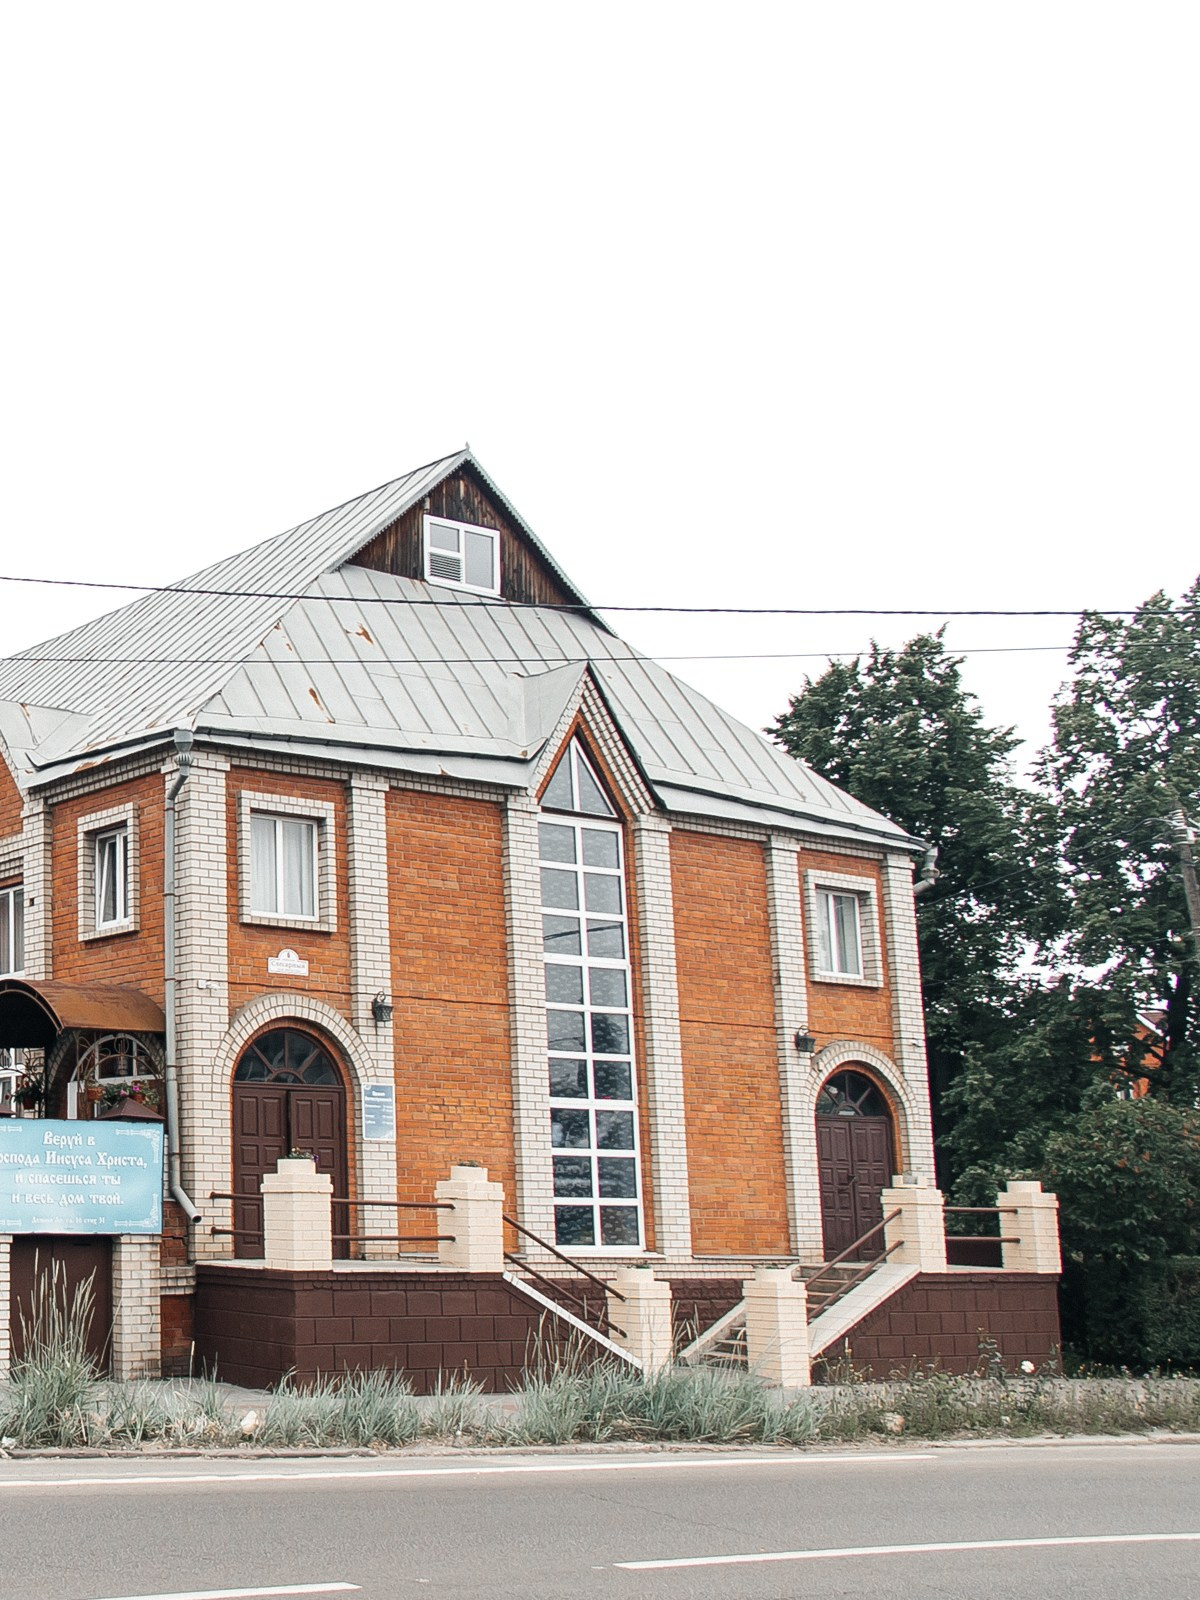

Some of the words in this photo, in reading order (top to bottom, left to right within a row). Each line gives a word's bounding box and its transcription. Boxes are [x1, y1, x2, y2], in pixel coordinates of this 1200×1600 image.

[43, 1131, 83, 1149] Веруй
[87, 1136, 95, 1146] в
[46, 1151, 92, 1168] Иисуса
[97, 1152, 147, 1169] Христа,
[28, 1175, 97, 1184] спасешься
[101, 1176, 120, 1185] ты
[25, 1194, 54, 1204] весь
[59, 1195, 84, 1206] дом
[89, 1194, 124, 1205] твой.
